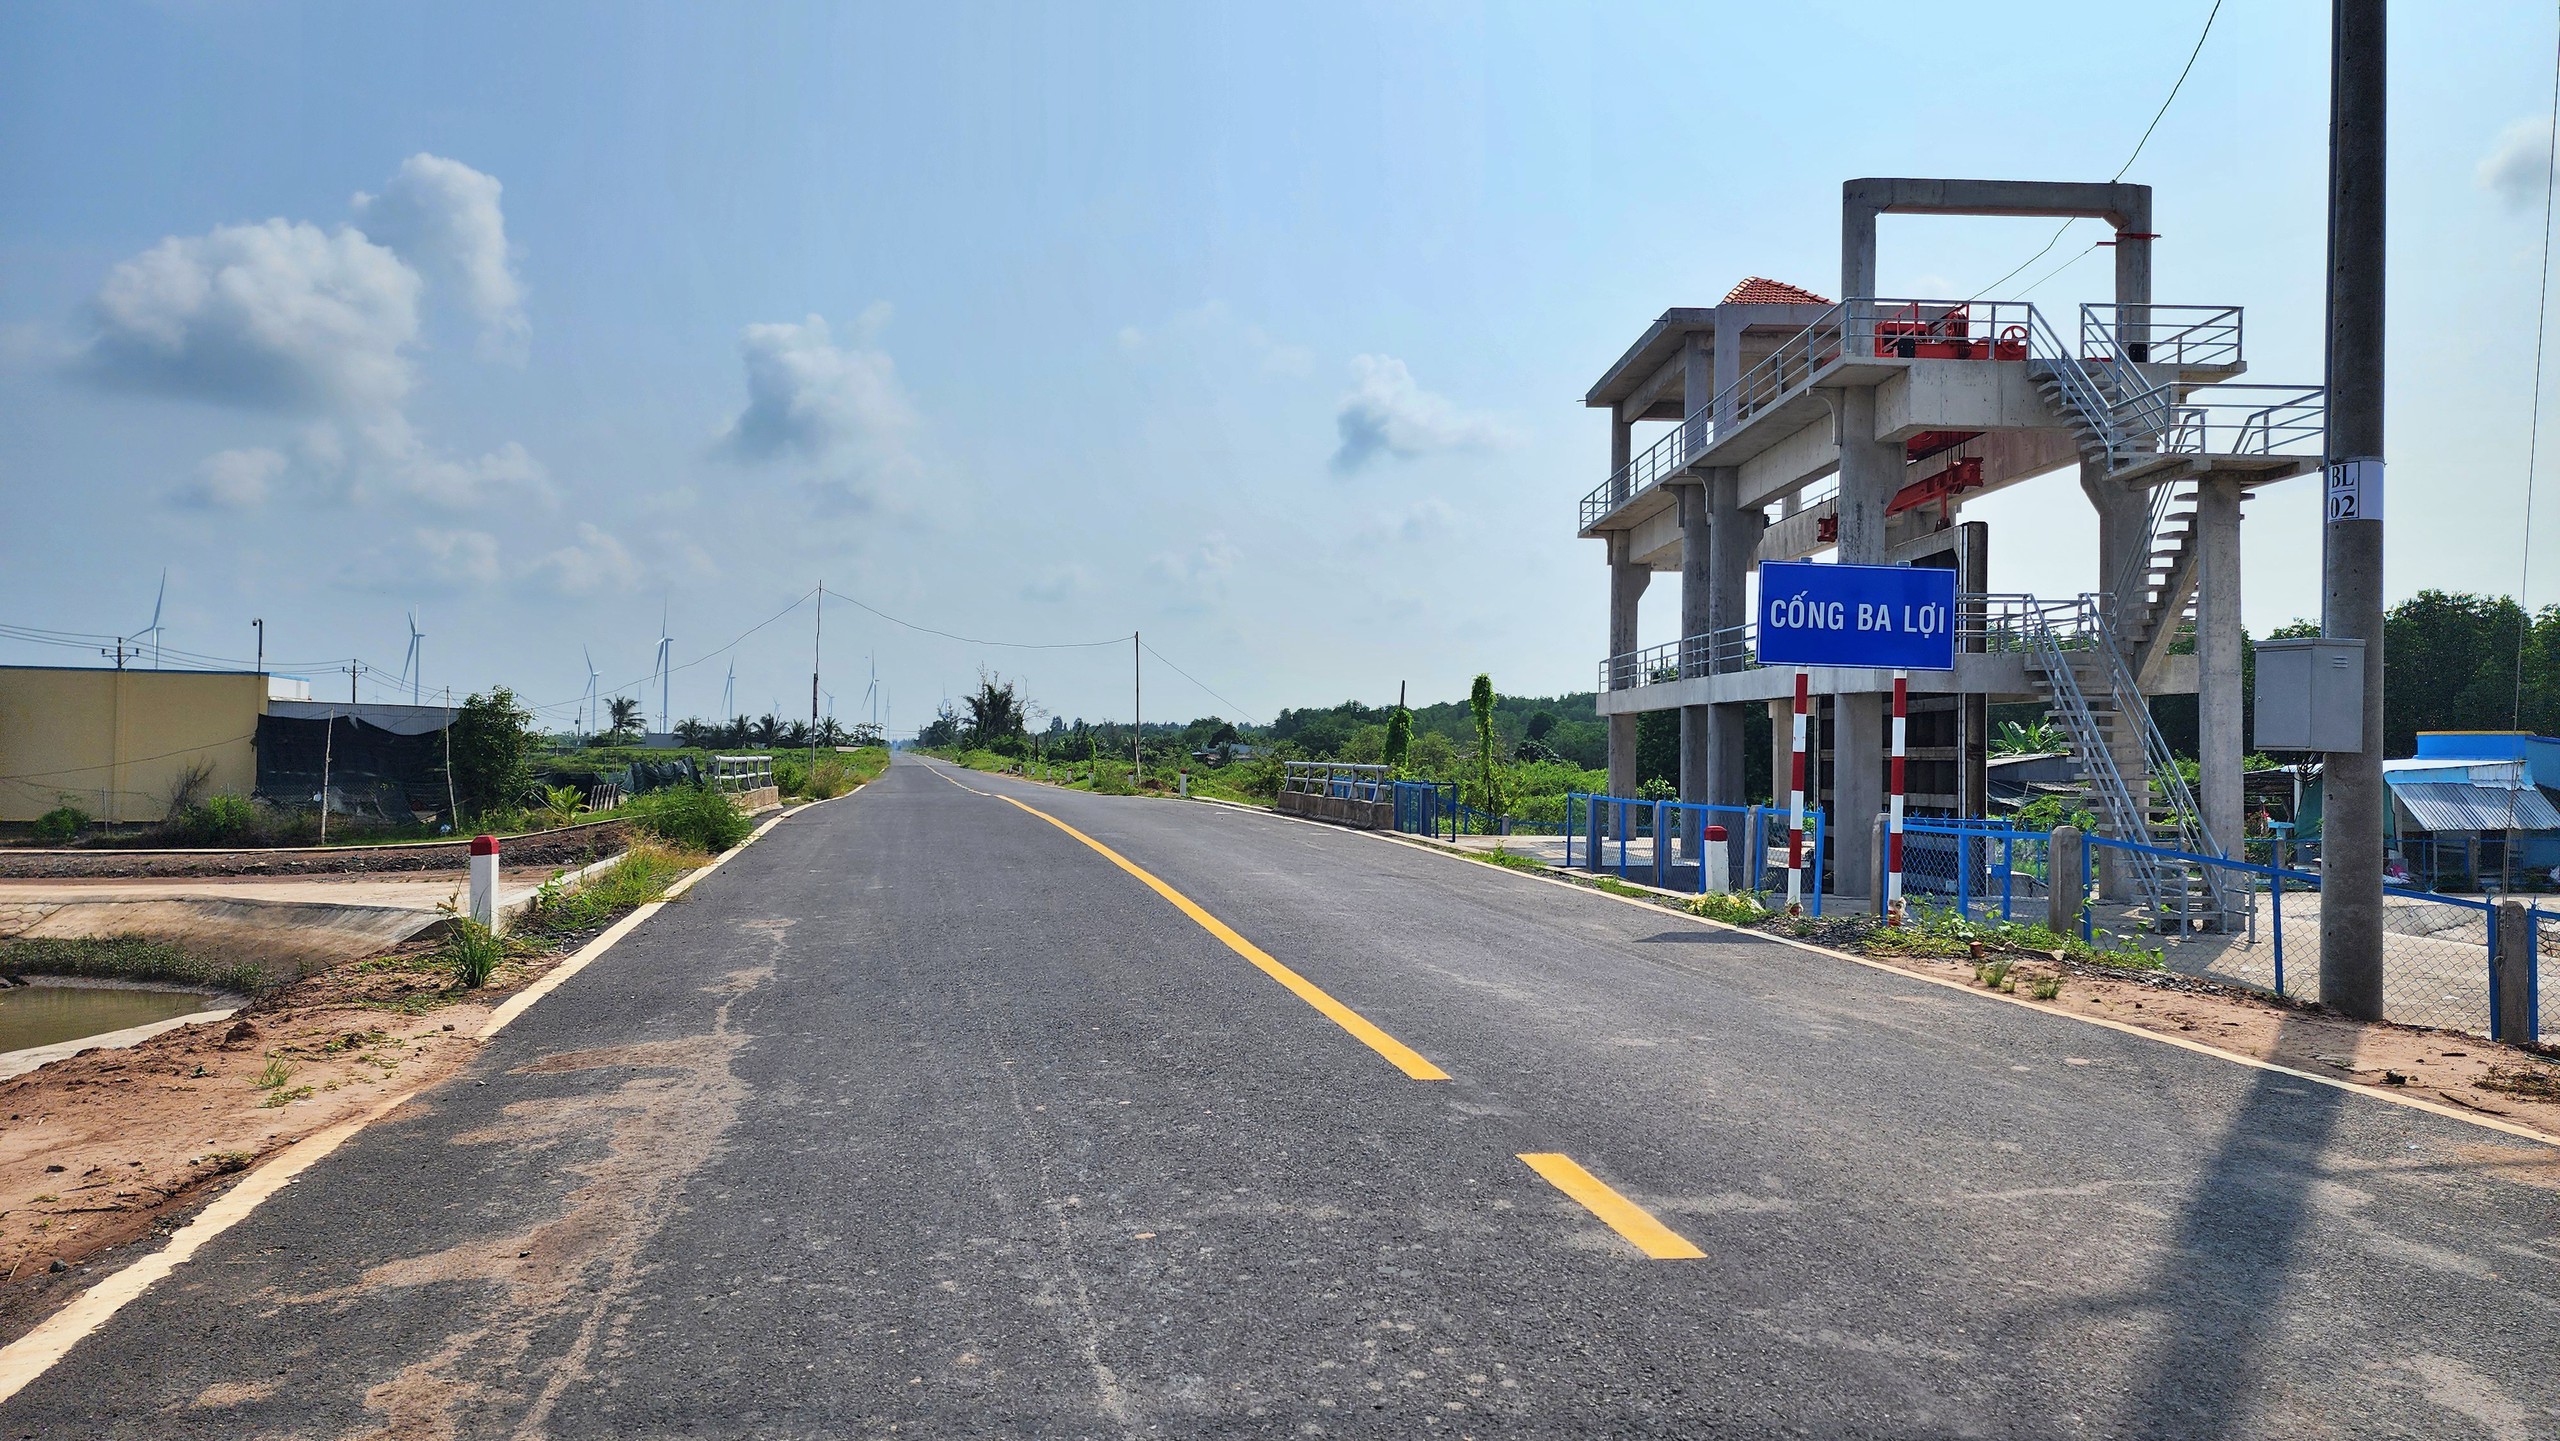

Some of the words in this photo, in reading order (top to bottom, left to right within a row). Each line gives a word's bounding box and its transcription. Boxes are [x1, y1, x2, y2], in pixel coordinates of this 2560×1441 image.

[2331, 464, 2355, 488] BL
[2330, 495, 2356, 519] 02
[1770, 590, 1844, 630] CỐNG
[1857, 603, 1892, 632] BA
[1904, 602, 1945, 639] LỢI
